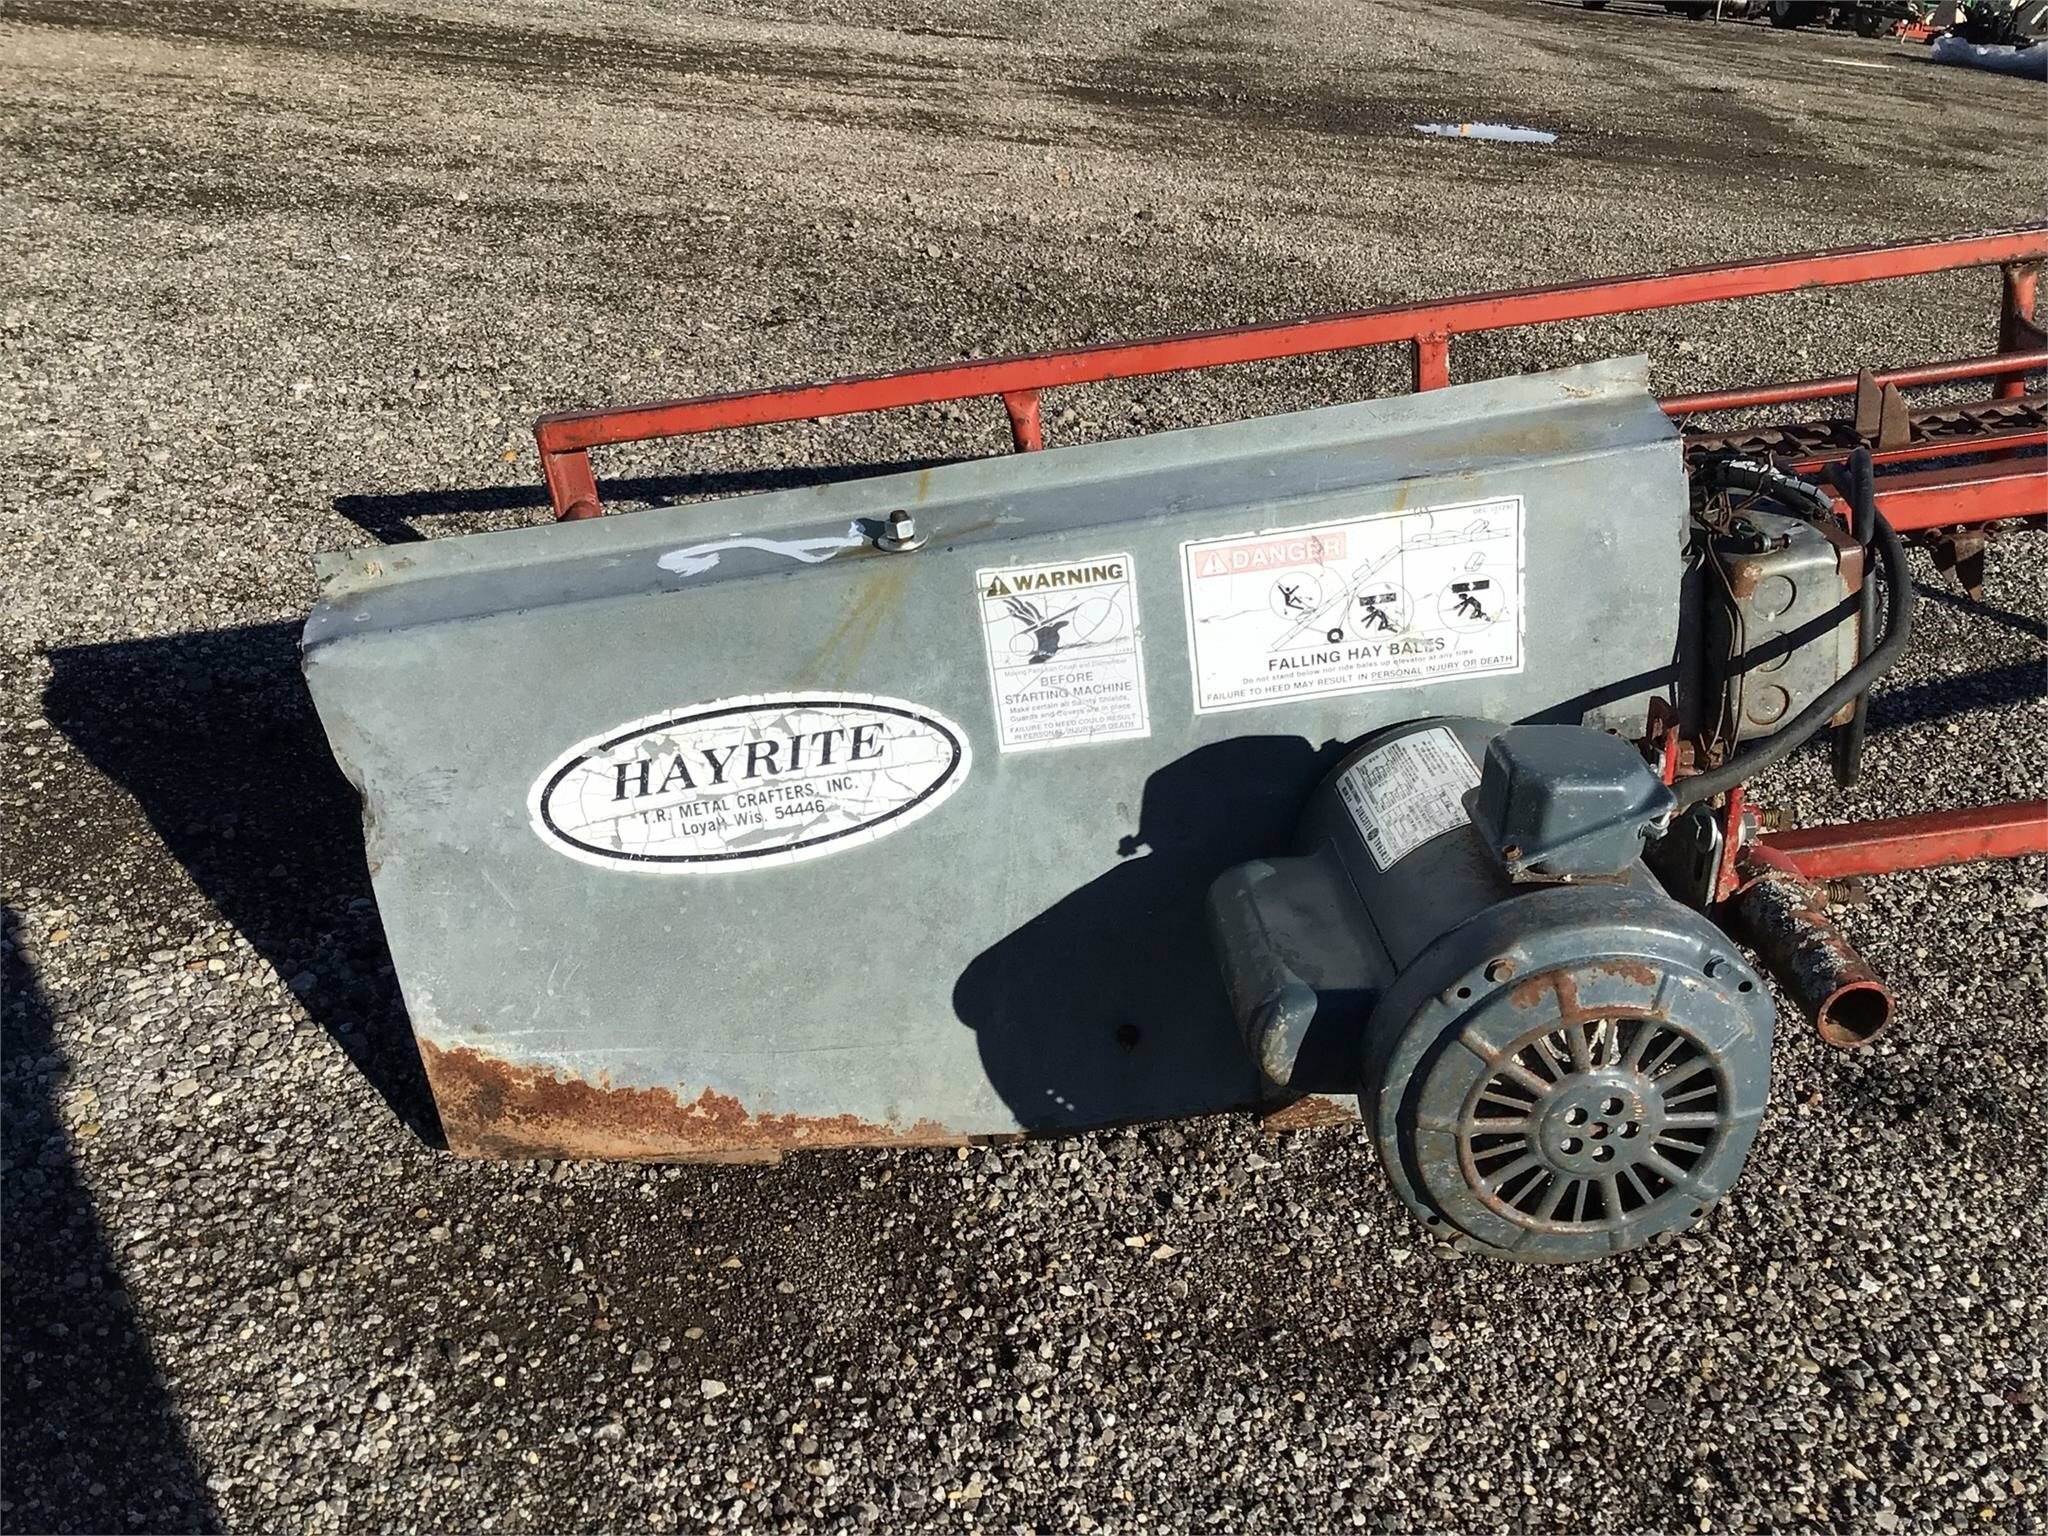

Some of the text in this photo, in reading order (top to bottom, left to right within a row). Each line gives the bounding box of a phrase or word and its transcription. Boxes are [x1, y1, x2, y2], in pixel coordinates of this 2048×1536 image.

[1232, 538, 1340, 569] DANGER
[1013, 564, 1123, 591] WARNING
[1269, 637, 1445, 671] FALLING HAY BALES
[1041, 672, 1093, 687] BEFORE
[1207, 689, 1247, 703] FAILURE
[1250, 687, 1262, 695] TO
[1265, 683, 1290, 693] HEED
[1293, 680, 1314, 689] MAY
[1318, 675, 1352, 686] RESULT
[1371, 667, 1422, 679] PERSONAL
[1426, 661, 1459, 672] INJURY
[1463, 659, 1477, 667] OR
[1480, 655, 1512, 665] DEATH
[1243, 677, 1254, 685] Do
[1272, 671, 1294, 680] stand
[1296, 667, 1320, 677] below
[1356, 660, 1378, 669] bales
[1394, 655, 1426, 665] elevator
[1005, 681, 1133, 705] STARTING MACHINE
[1044, 722, 1054, 730] TO
[1078, 716, 1105, 725] COULD
[611, 723, 884, 801] HAYRITE
[640, 808, 671, 825] T.R.
[679, 800, 730, 818] METAL
[827, 776, 858, 793] INC.
[734, 810, 768, 827] Wis.
[774, 799, 825, 819] 54446
